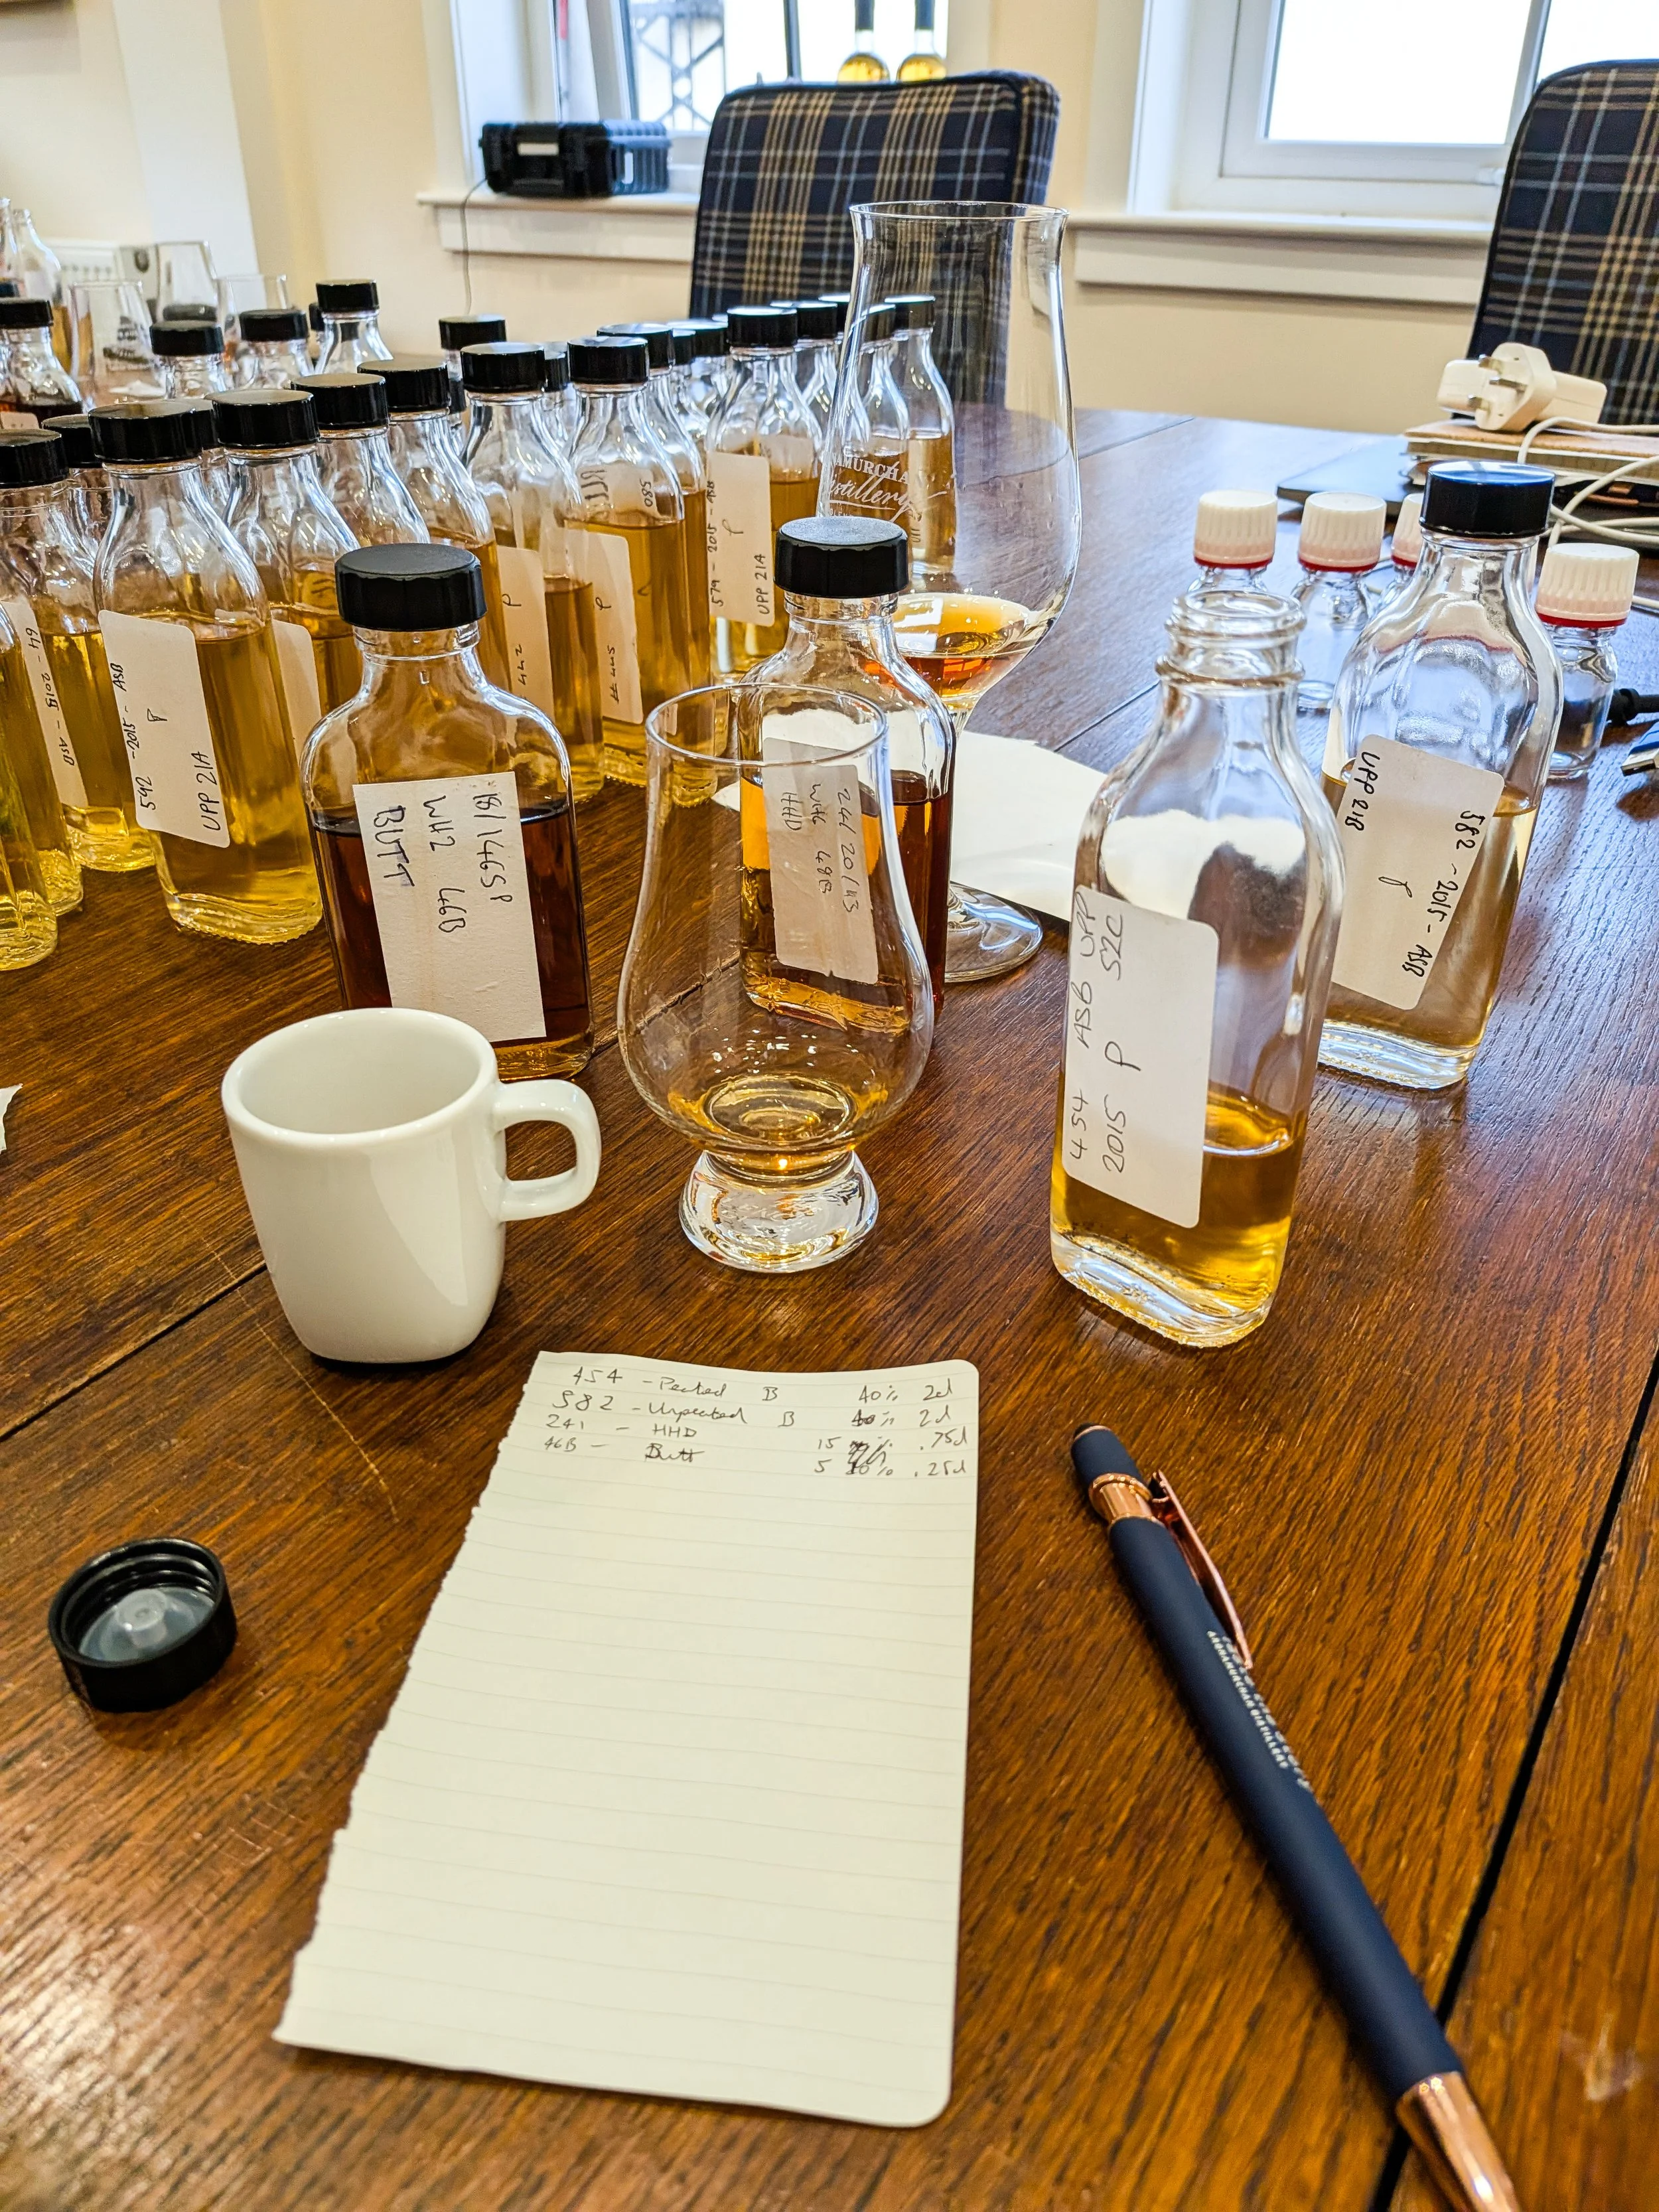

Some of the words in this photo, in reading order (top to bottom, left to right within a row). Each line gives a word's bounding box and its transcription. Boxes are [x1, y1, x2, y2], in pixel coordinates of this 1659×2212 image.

[832, 456, 909, 484] AMURCHA
[830, 461, 932, 522] istillery
[707, 523, 717, 553] 2015
[754, 553, 768, 581] 21A
[502, 593, 522, 608] P
[756, 587, 770, 615] UPP
[190, 751, 218, 786] 21A
[1353, 751, 1381, 796] UPP
[198, 792, 222, 832] UPP
[780, 791, 803, 832] HHD
[1455, 809, 1486, 851] 582
[373, 805, 415, 887] BUTT
[1074, 891, 1096, 958] UPP
[1070, 980, 1093, 1049] ASB
[1104, 1040, 1141, 1072] P
[1070, 1088, 1088, 1161] 454
[1102, 1093, 1127, 1175] 2015
[573, 1366, 623, 1386] 454
[762, 1386, 779, 1402] B
[552, 1390, 614, 1412] 582
[777, 1410, 796, 1428] B
[545, 1413, 585, 1430] 241
[652, 1423, 697, 1439] HHD
[817, 1436, 843, 1450] 15
[644, 1441, 705, 1463] Butt
[814, 1458, 833, 1474] 5
